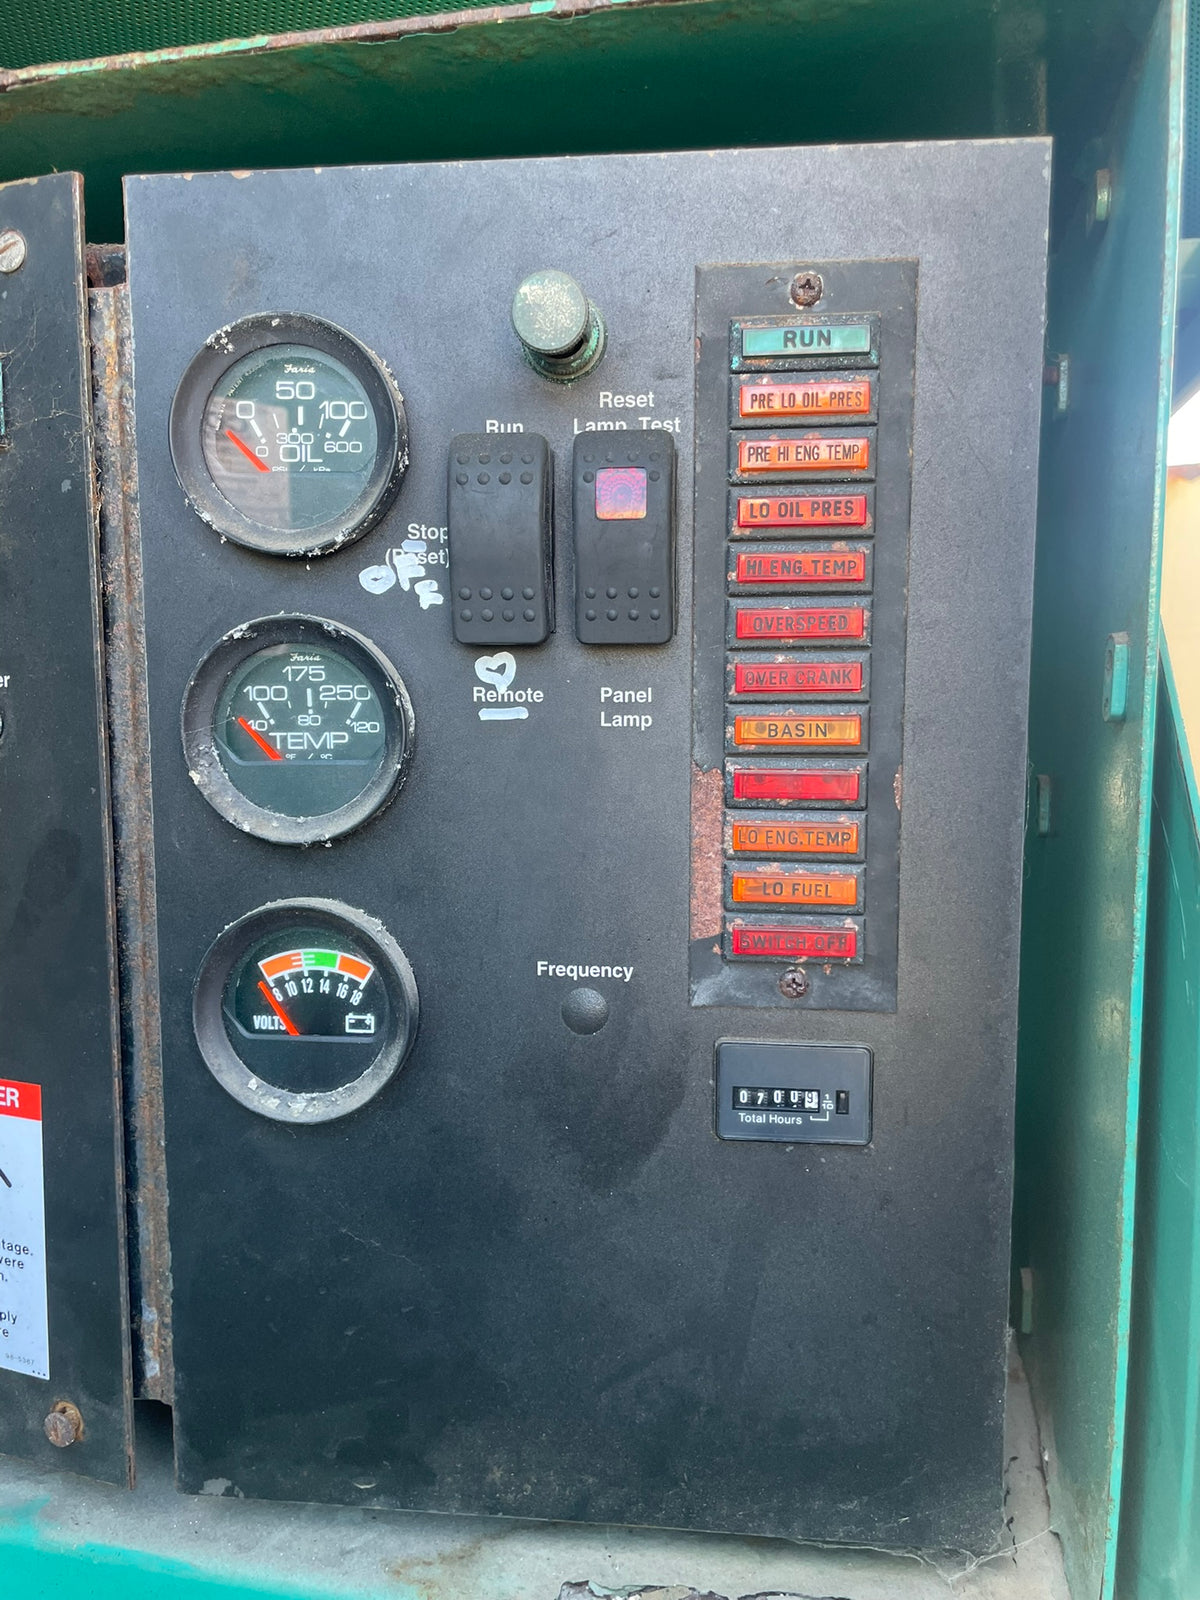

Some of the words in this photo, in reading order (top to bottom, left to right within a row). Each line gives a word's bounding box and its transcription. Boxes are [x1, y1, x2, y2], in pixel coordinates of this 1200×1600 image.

[783, 329, 831, 348] RUN
[276, 381, 315, 399] 50
[599, 392, 654, 408] Reset
[750, 394, 774, 409] PRE
[782, 393, 796, 408] LO
[802, 392, 821, 407] OIL
[829, 391, 862, 407] PRES
[236, 401, 254, 418] 0
[319, 401, 367, 419] 100
[486, 420, 524, 433] Run
[639, 417, 681, 433] Test
[276, 433, 313, 444] 300
[256, 446, 268, 457] 0
[280, 445, 323, 462] OIL
[324, 442, 362, 452] 600
[748, 446, 771, 462] PRE
[778, 446, 789, 461] HI
[795, 445, 820, 461] ENG
[826, 445, 859, 460] TEMP
[750, 503, 770, 518] LO
[778, 502, 803, 518] OIL
[811, 500, 854, 516] PRES
[408, 523, 448, 543] Stop
[746, 560, 762, 574] HI
[812, 559, 857, 574] TEMP
[753, 615, 848, 632] OVERSPEED
[282, 666, 325, 682] 175
[745, 671, 788, 686] OVER
[795, 669, 853, 685] CRANK
[243, 686, 288, 701] 100
[319, 685, 370, 700] 250
[473, 687, 544, 702] Remote
[601, 687, 652, 703] Panel
[298, 715, 321, 726] 80
[350, 722, 379, 733] 120
[601, 711, 652, 730] Lamp
[768, 723, 828, 738] BASIN
[269, 732, 349, 749] TEMP
[738, 830, 758, 844] LO
[763, 882, 783, 896] LO
[791, 883, 832, 898] FUEL
[740, 935, 806, 949] SWITCH
[815, 935, 847, 950] OFF
[537, 961, 634, 982] Frequency
[272, 988, 283, 1001] 8
[285, 981, 298, 997] 10
[301, 978, 314, 993] 12
[319, 979, 330, 994] 14
[336, 983, 349, 999] 16
[350, 990, 363, 1005] 18
[738, 1113, 766, 1123] Total
[769, 1114, 802, 1125] Hours
